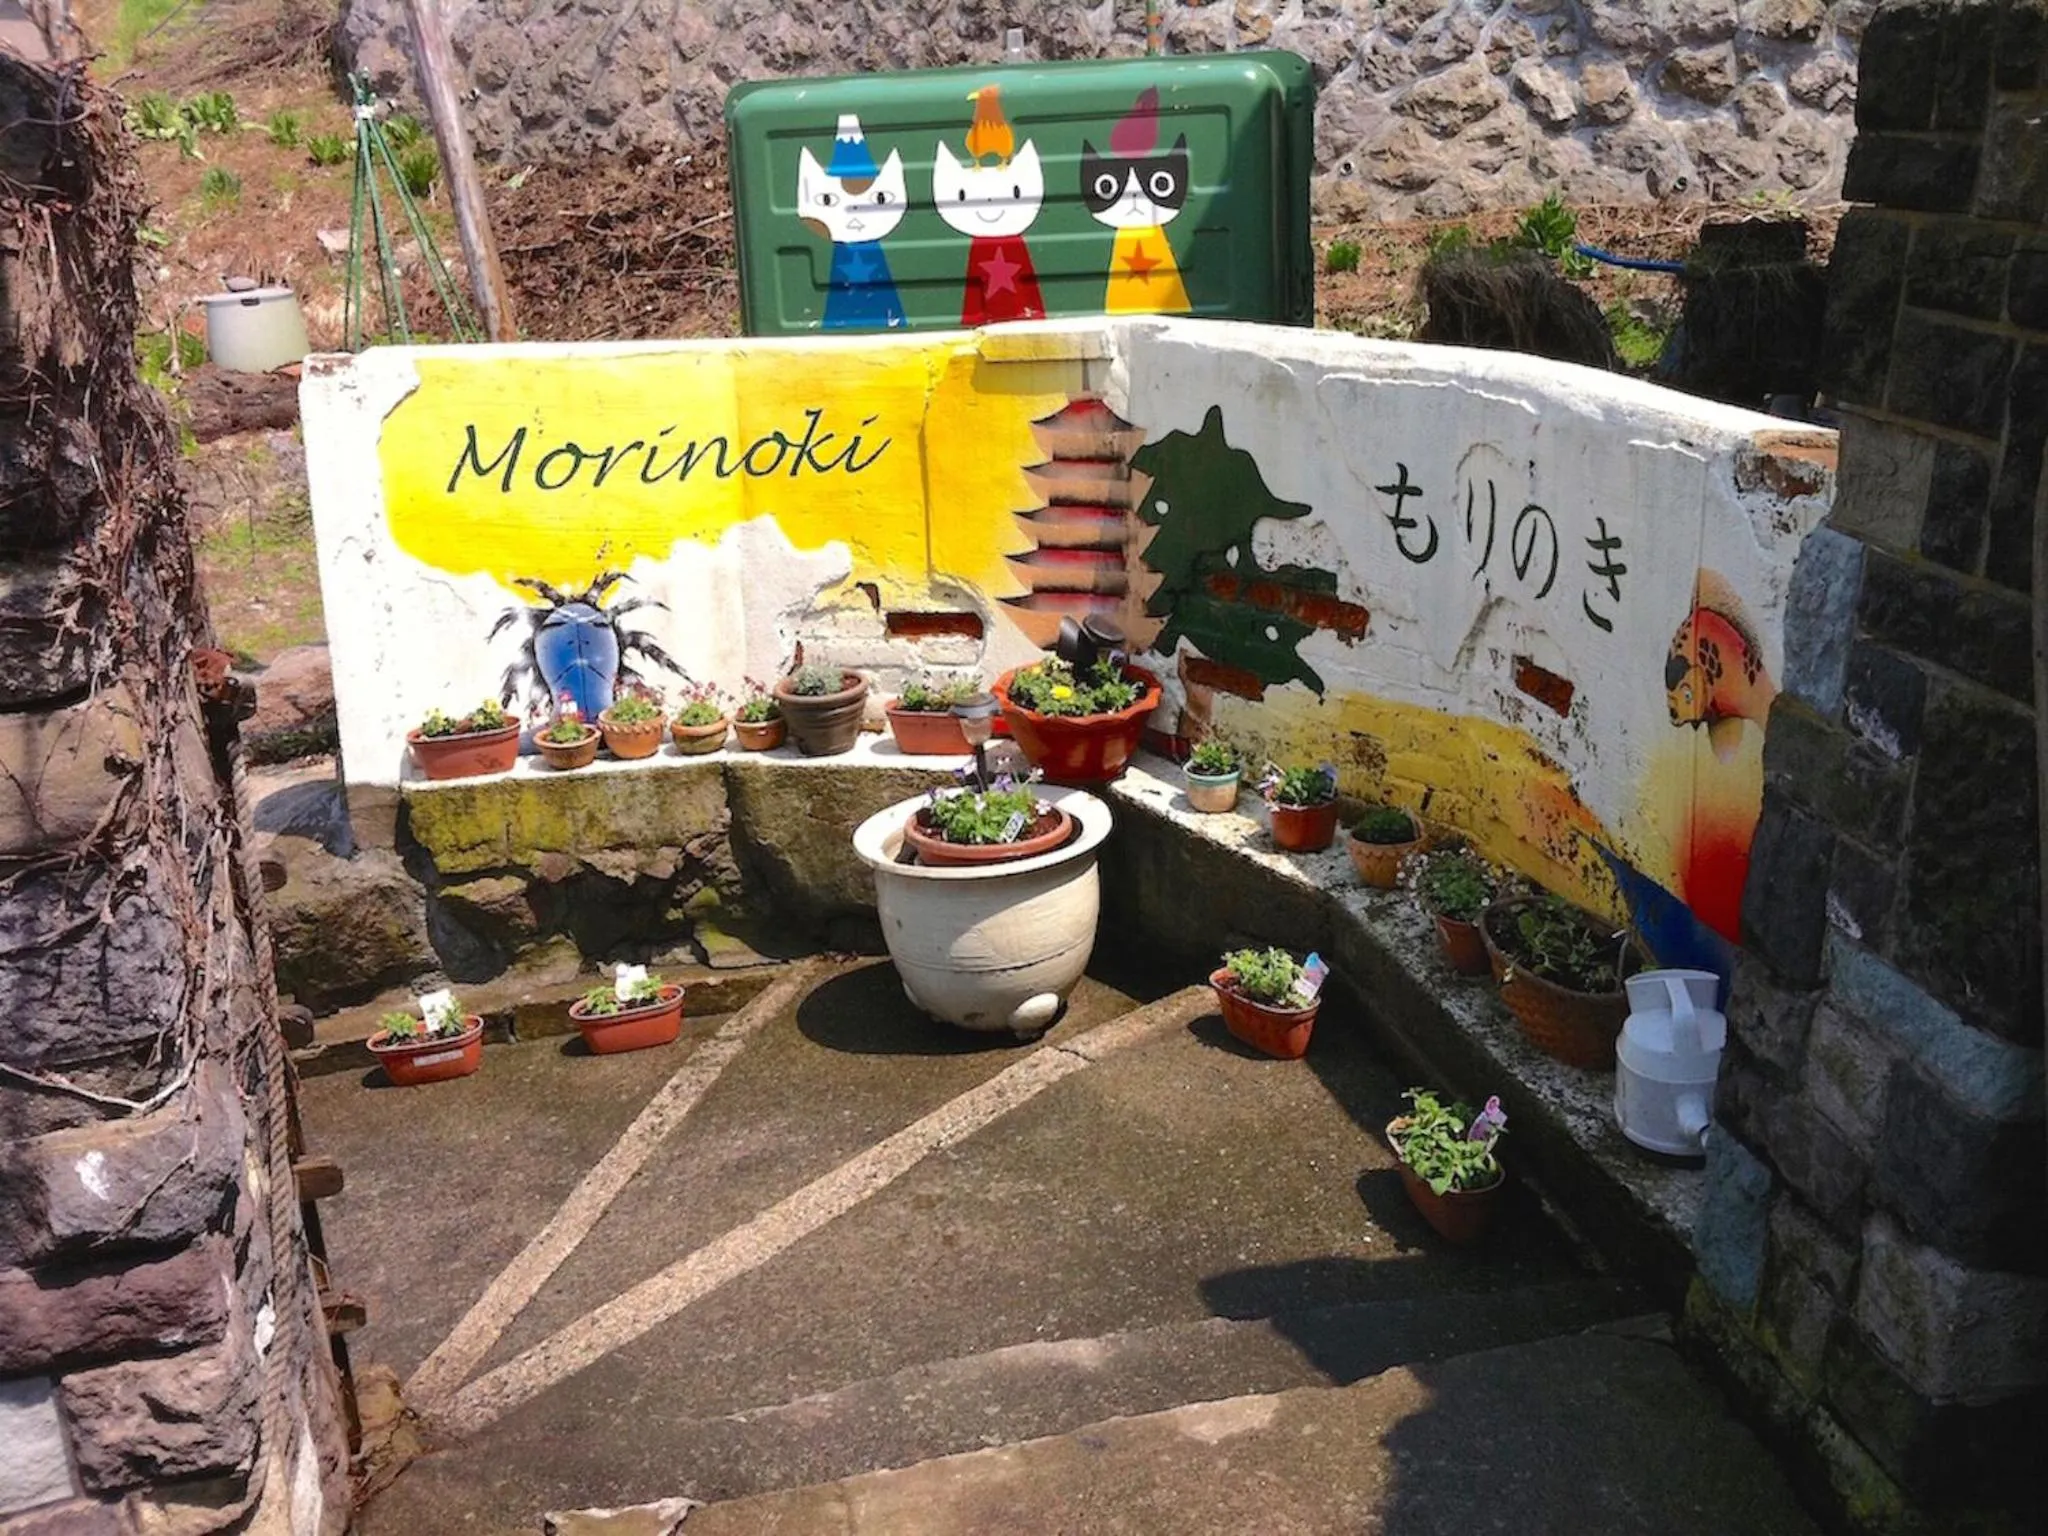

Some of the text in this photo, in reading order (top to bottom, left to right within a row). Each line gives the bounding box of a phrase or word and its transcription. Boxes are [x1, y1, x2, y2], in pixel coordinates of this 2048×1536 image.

[447, 408, 892, 493] Morinoki
[1375, 461, 1626, 632] もりのき
